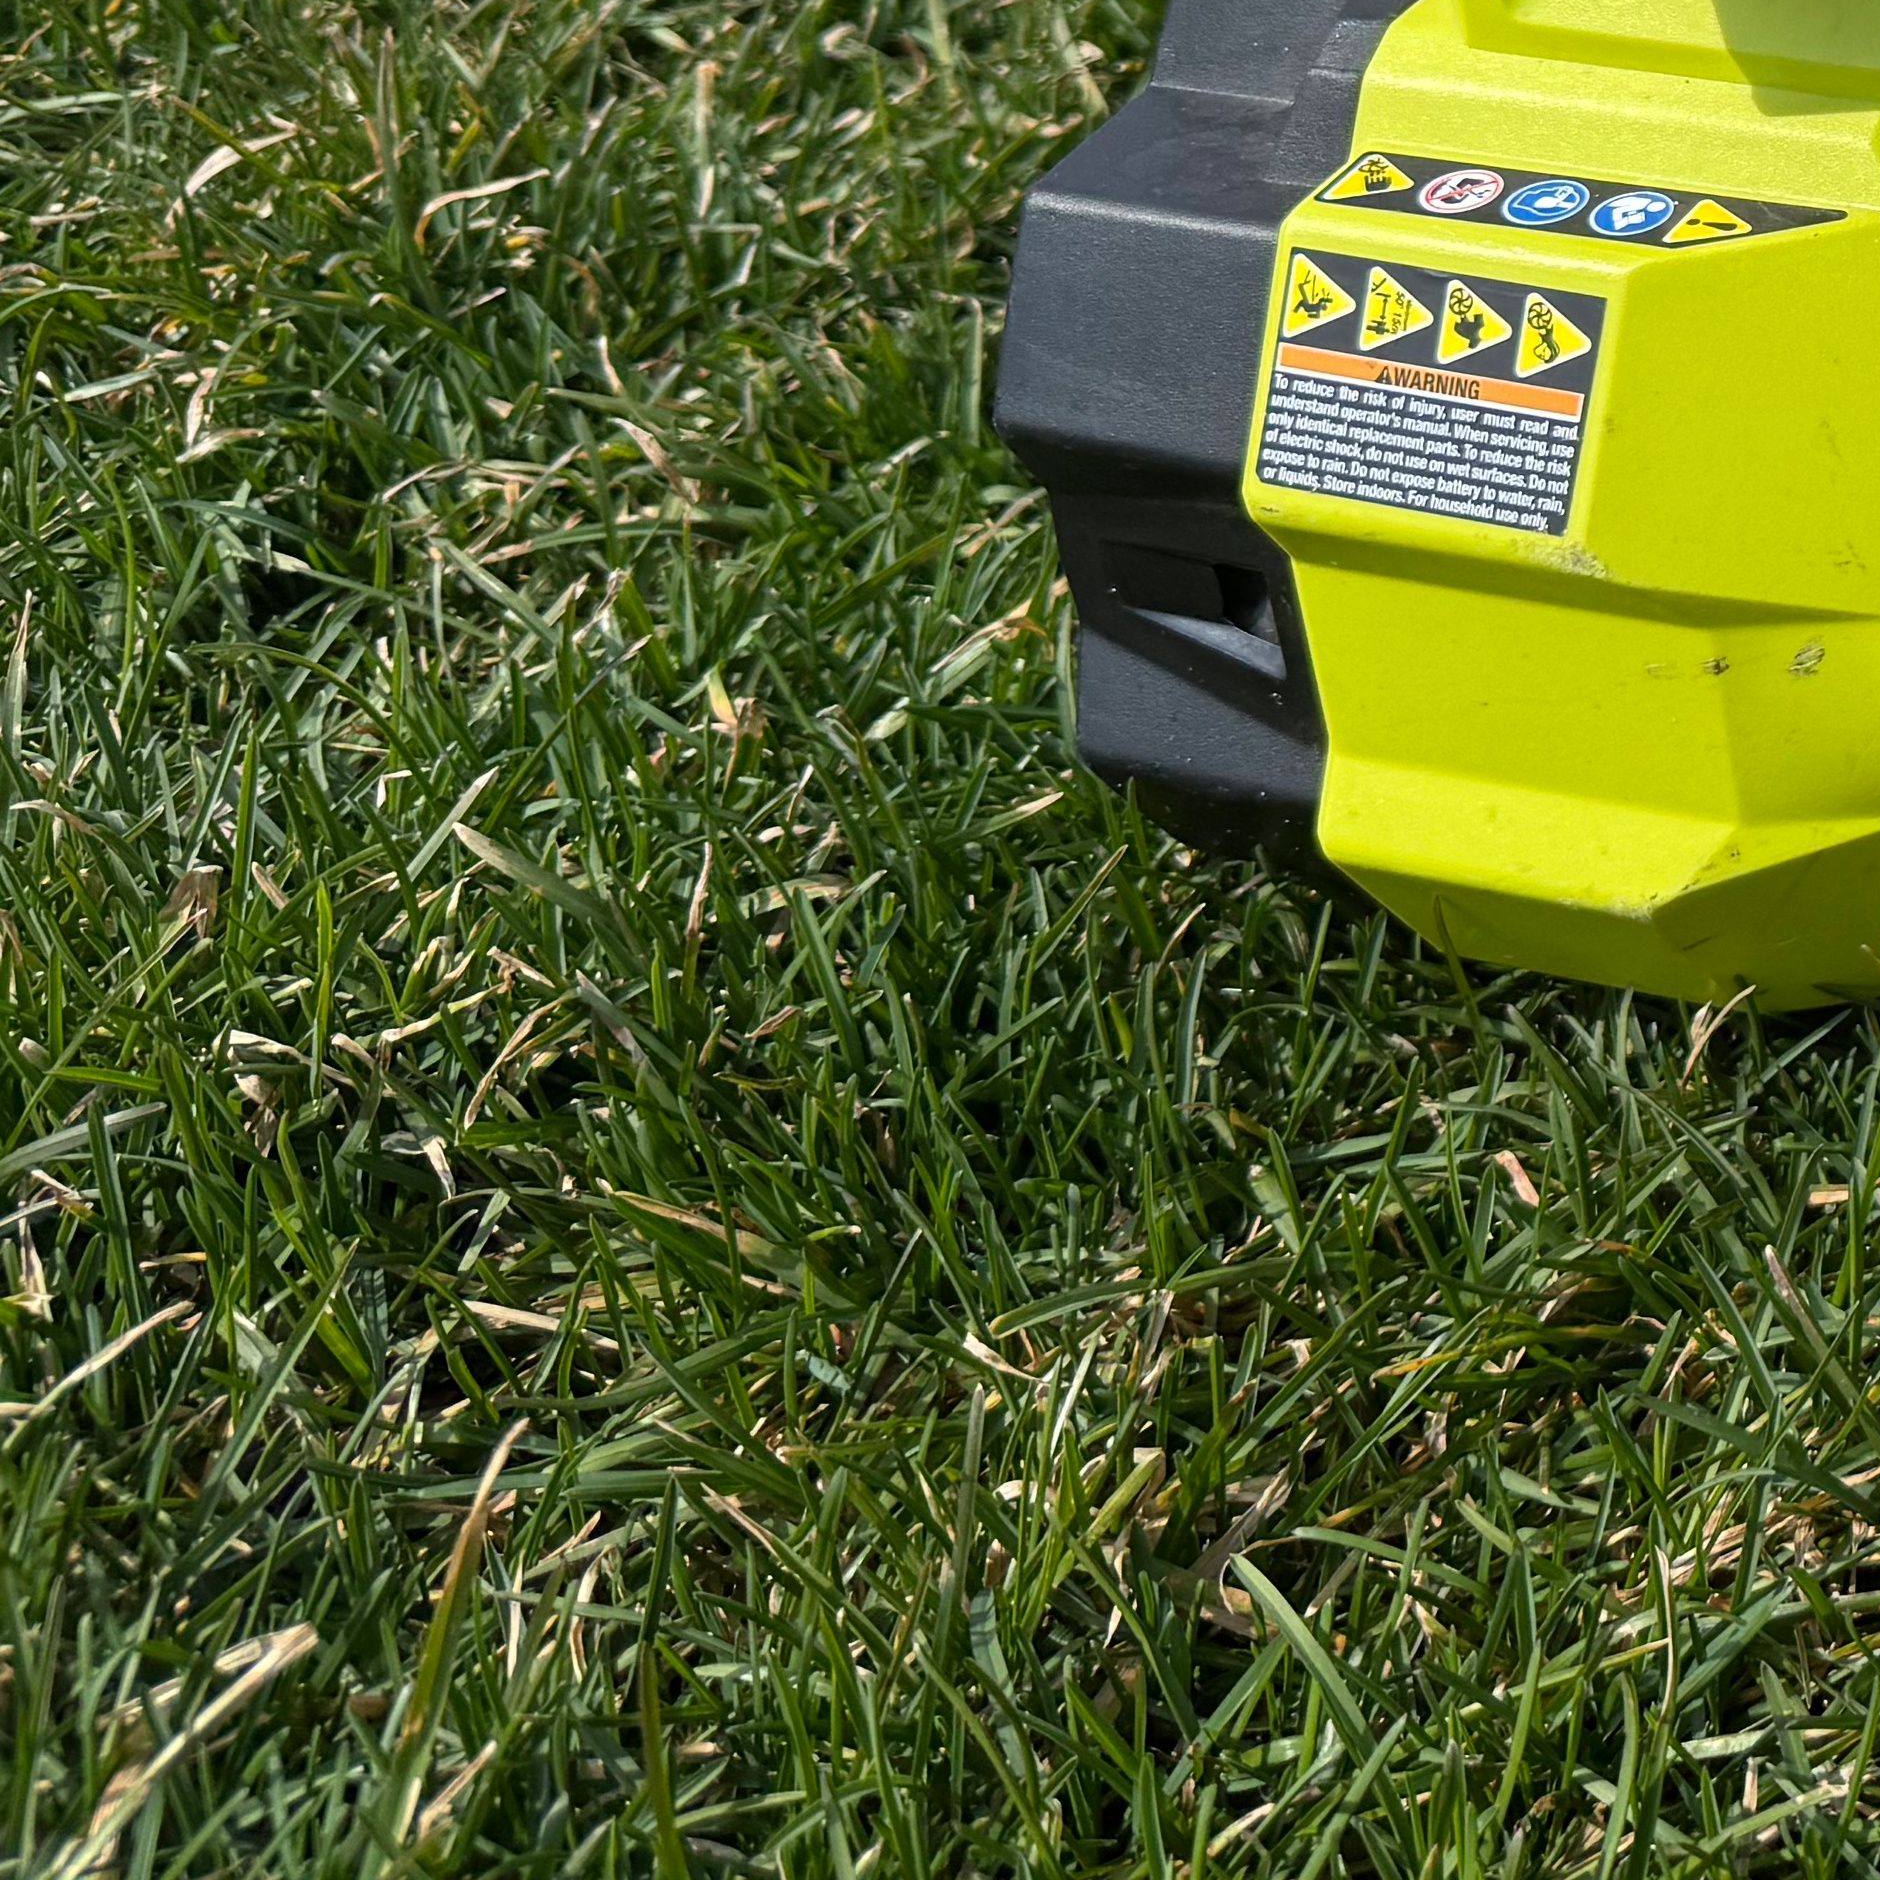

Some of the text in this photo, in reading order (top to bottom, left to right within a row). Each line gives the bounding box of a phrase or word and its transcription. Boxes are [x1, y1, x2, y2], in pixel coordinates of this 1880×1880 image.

[1275, 373, 1288, 389] To
[1292, 380, 1334, 397] reduce
[1339, 386, 1359, 401] the
[1363, 390, 1387, 406] risk
[1392, 396, 1405, 409] of
[1409, 397, 1446, 419] injury,
[1451, 408, 1479, 422] user
[1483, 413, 1515, 429] must
[1519, 420, 1549, 435] read
[1392, 370, 1479, 399] WARNING
[1268, 412, 1571, 476] only identical replacement parts. To reduce the risk
[1271, 395, 1574, 458] understand operator's manual. When servicing, use
[1262, 449, 1565, 515] expose to rain. Do not expose battery to water, rain,
[1265, 428, 1569, 494] of electric shock, do not use on wet surfaces. Do not
[1263, 467, 1277, 478] or
[1323, 475, 1355, 494] Store
[1357, 480, 1408, 502] indoors.
[1408, 490, 1429, 506] For
[1430, 494, 1494, 518] household
[1495, 509, 1518, 523] use
[1520, 512, 1548, 532] only.
